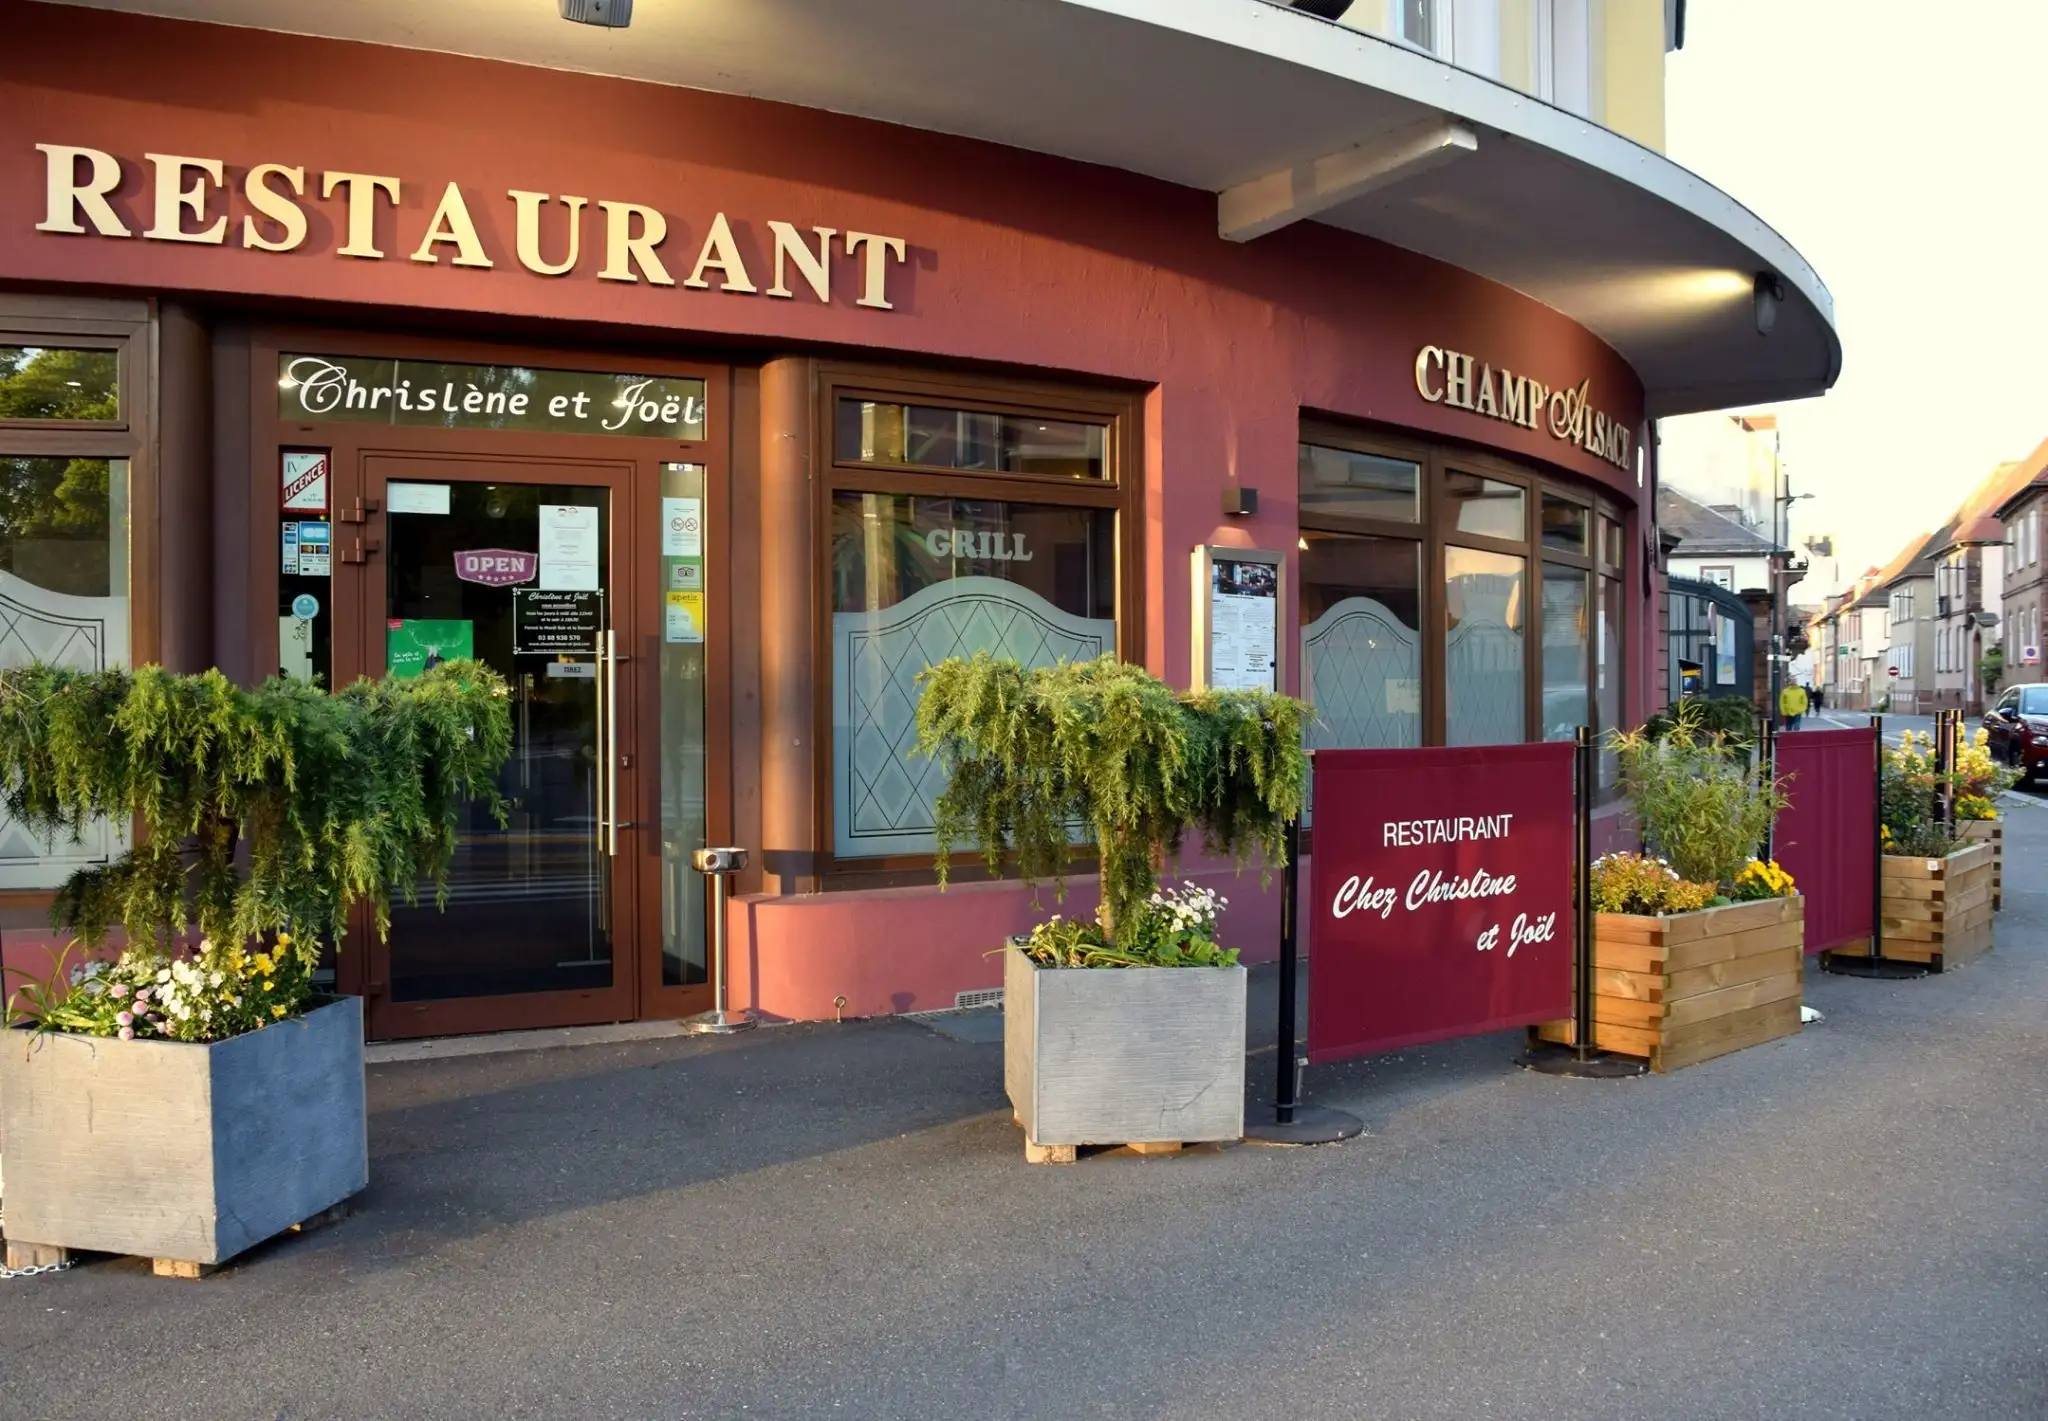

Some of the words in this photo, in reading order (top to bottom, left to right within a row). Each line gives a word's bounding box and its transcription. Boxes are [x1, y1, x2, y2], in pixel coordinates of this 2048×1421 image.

[35, 142, 907, 310] RESTAURANT
[288, 357, 529, 415] Chrislène
[548, 390, 591, 419] et
[601, 379, 699, 431] Joël
[284, 461, 325, 501] LICENCE
[465, 556, 526, 573] OPEN
[926, 528, 1033, 561] GRILL
[1383, 814, 1513, 848] RESTAURANT
[1332, 875, 1398, 920] Chez
[1405, 868, 1517, 911] Chrislène
[1476, 924, 1500, 951] et
[1507, 912, 1556, 958] Joël
